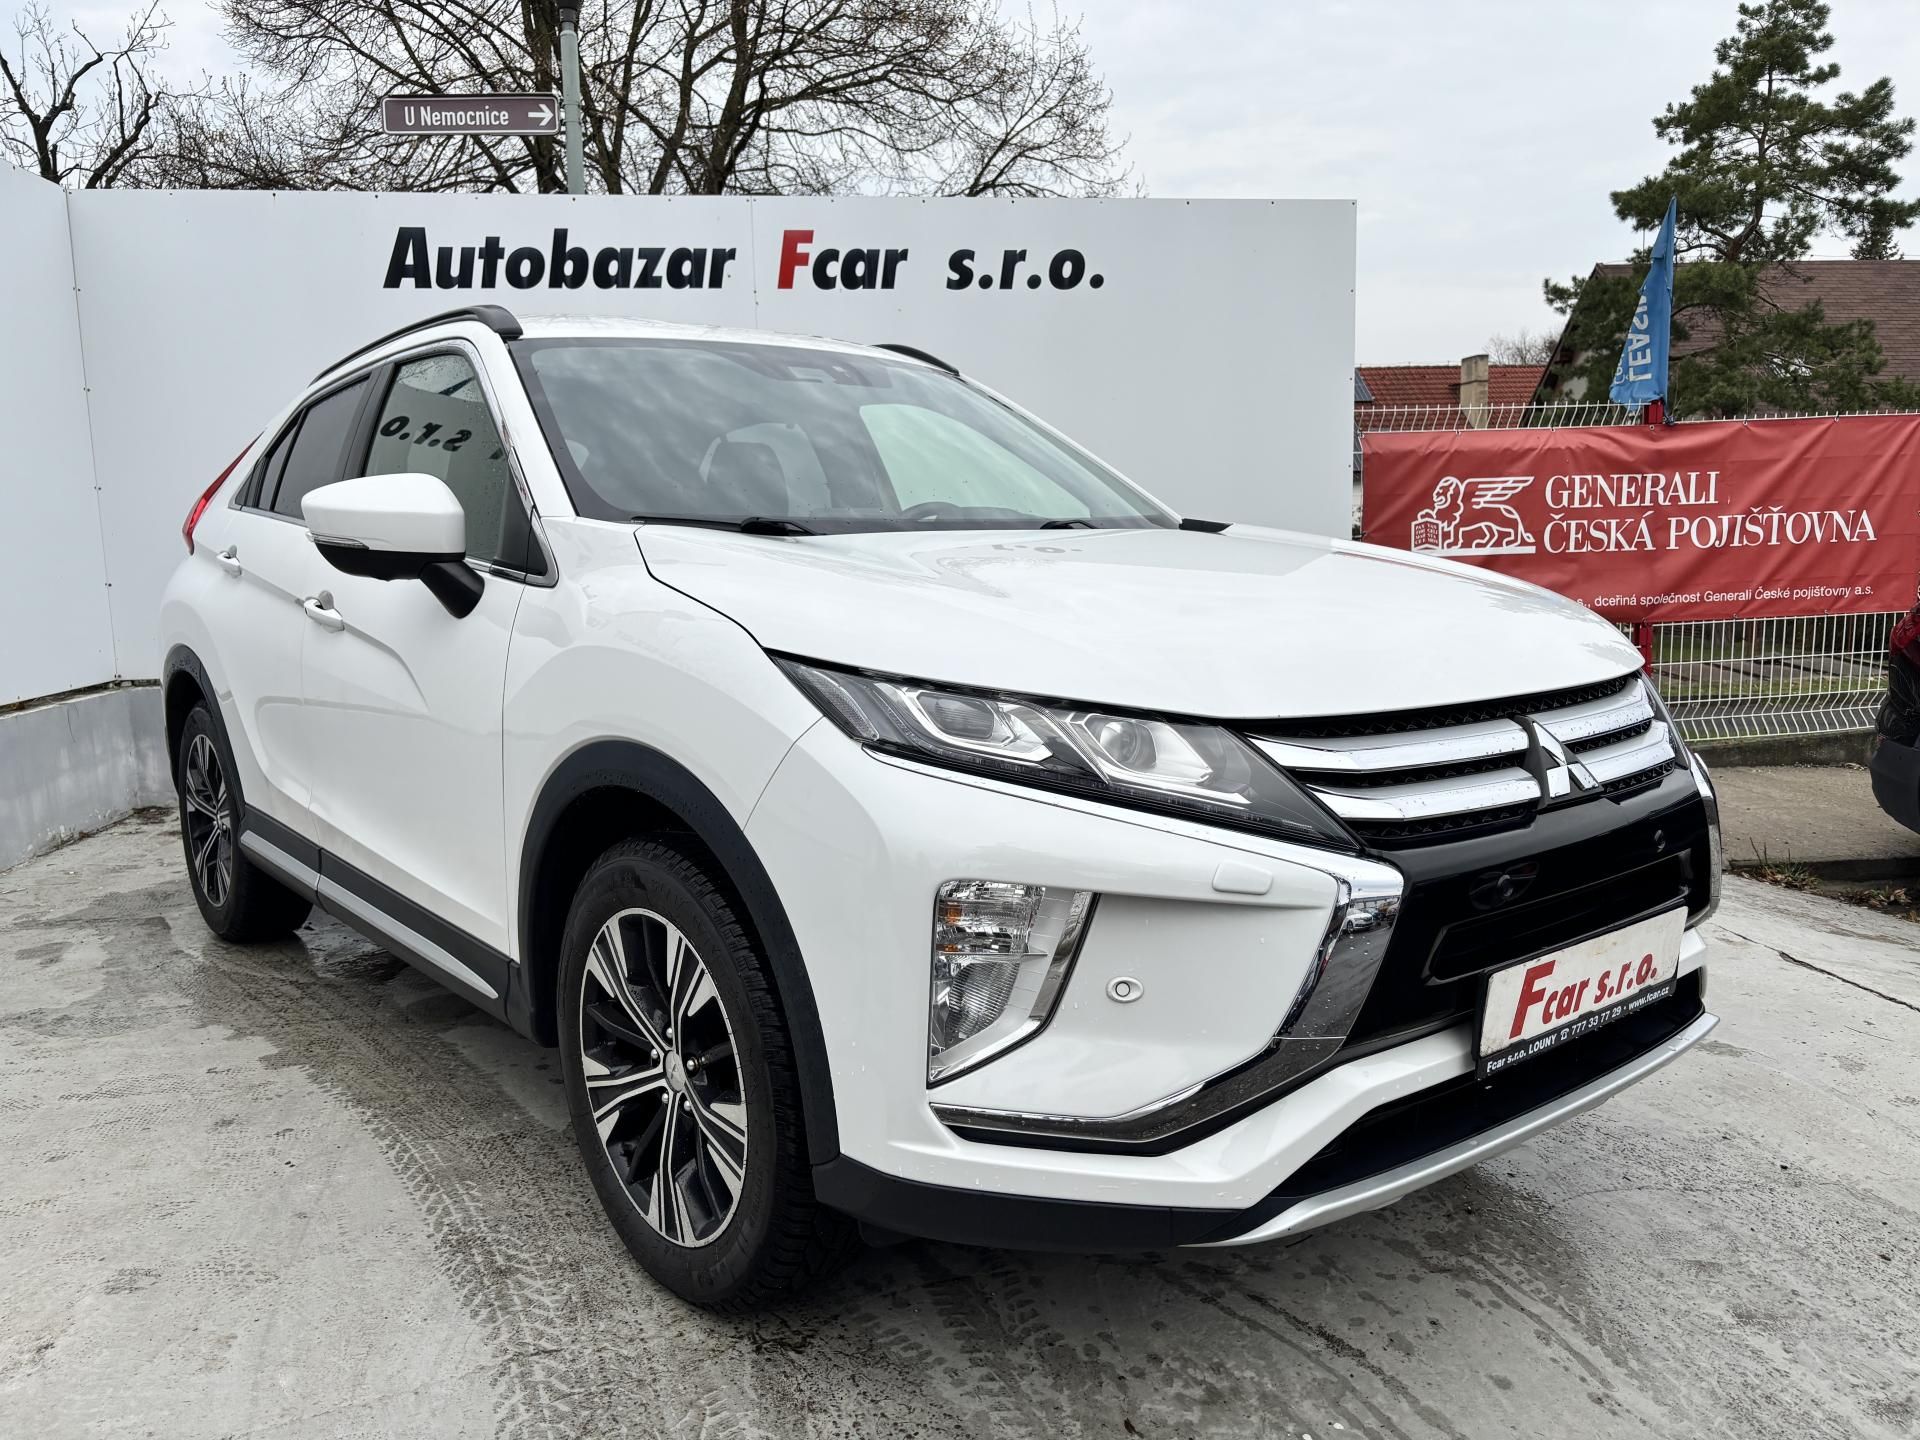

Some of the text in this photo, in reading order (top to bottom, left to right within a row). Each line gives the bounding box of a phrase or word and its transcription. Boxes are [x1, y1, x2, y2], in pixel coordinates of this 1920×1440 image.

[404, 105, 509, 127] U Nemocnice
[383, 227, 1104, 291] Autobazar Fcar s.r.o.
[1545, 471, 1720, 509] GENERALI
[1543, 505, 1877, 554] ČESKÁ POJIŠŤOVNA
[1594, 595, 1637, 607] dceřiná
[1640, 591, 1700, 607] společnost
[1703, 589, 1752, 602] Generali
[1754, 586, 1790, 600] České
[1793, 585, 1851, 601] pojišťovny
[1854, 585, 1874, 595] a.s.
[1509, 953, 1658, 1040] Fcar s.r.o.
[1487, 986, 1670, 1073] Fcar s.r.o. LOUNY 777 33 77 29 www.fcar.cz
